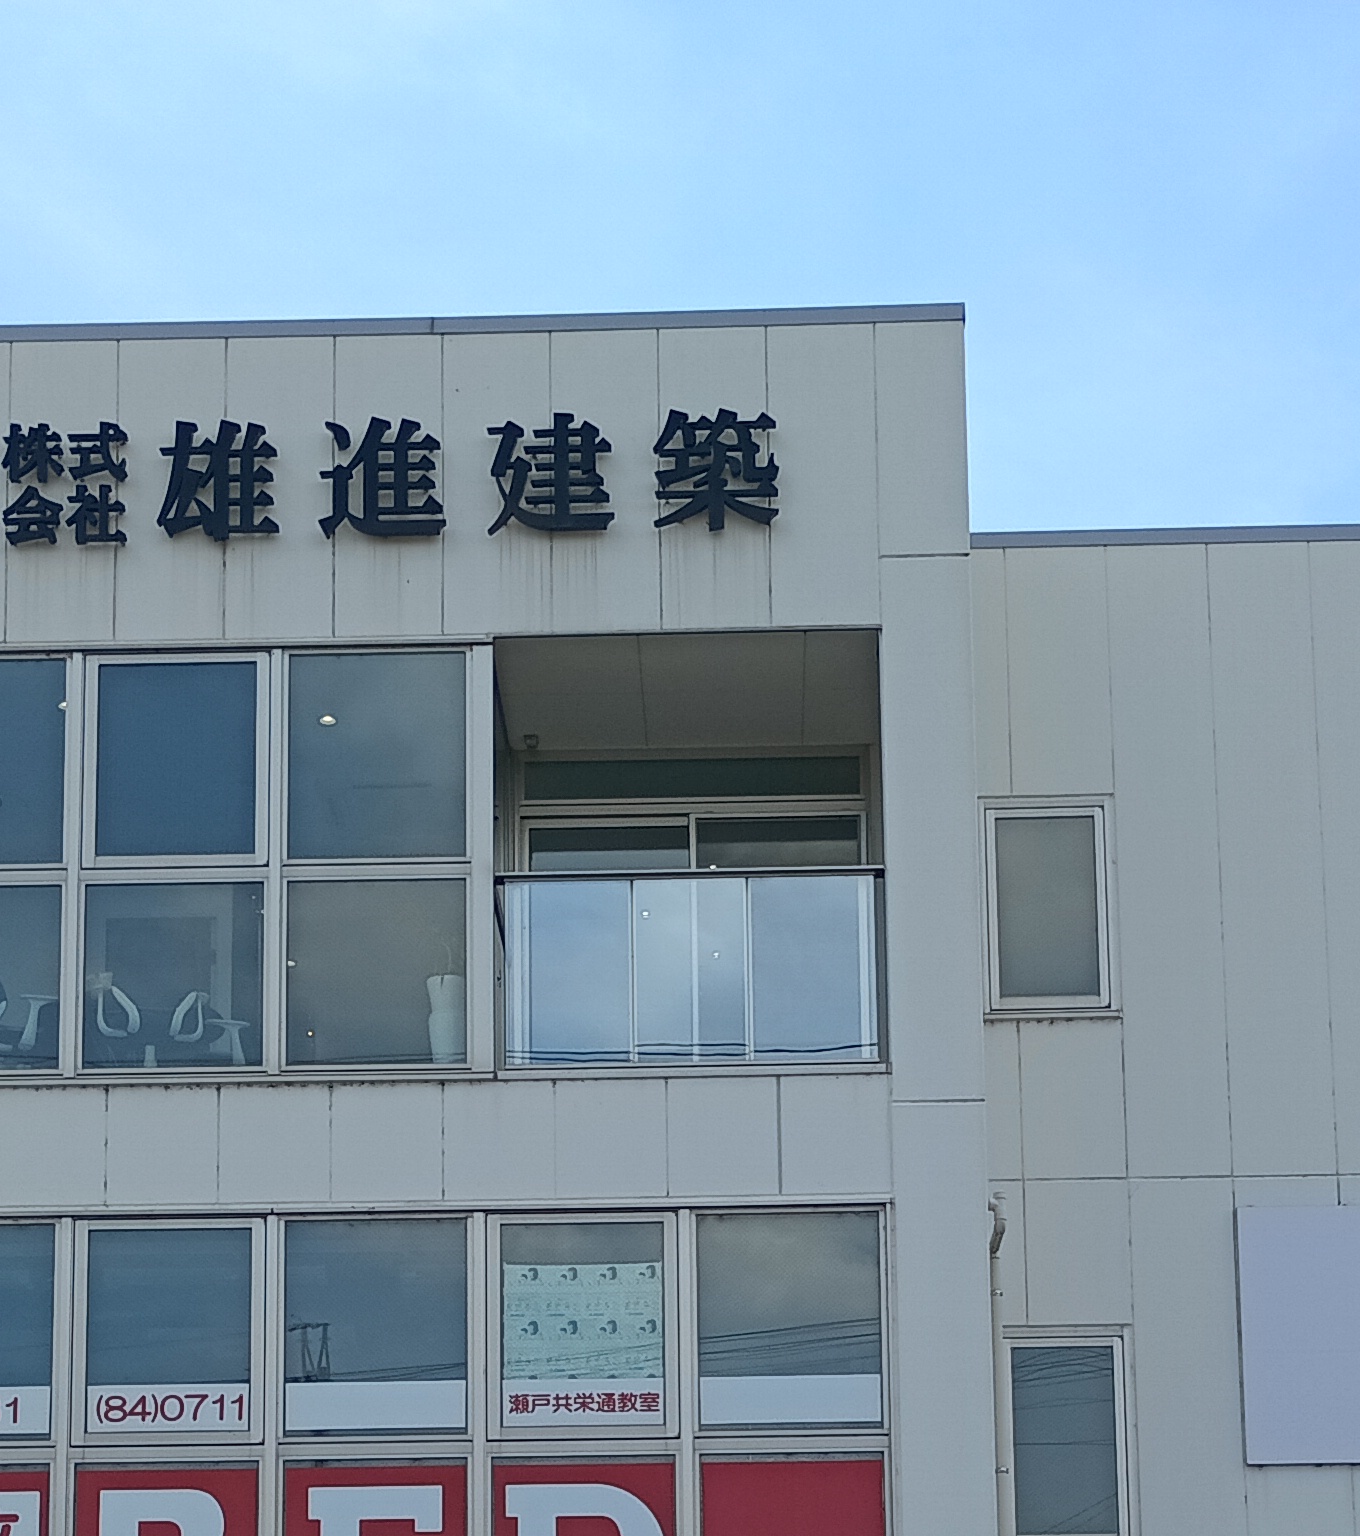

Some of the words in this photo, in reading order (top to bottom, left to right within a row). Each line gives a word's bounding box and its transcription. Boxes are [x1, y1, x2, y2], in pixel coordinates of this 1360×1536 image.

[2, 421, 129, 482] 株式
[156, 408, 781, 541] 雄進建築
[1, 484, 128, 546] 会社
[96, 1393, 245, 1425] (84)0711
[508, 1391, 660, 1416] 瀬戸共栄通教室
